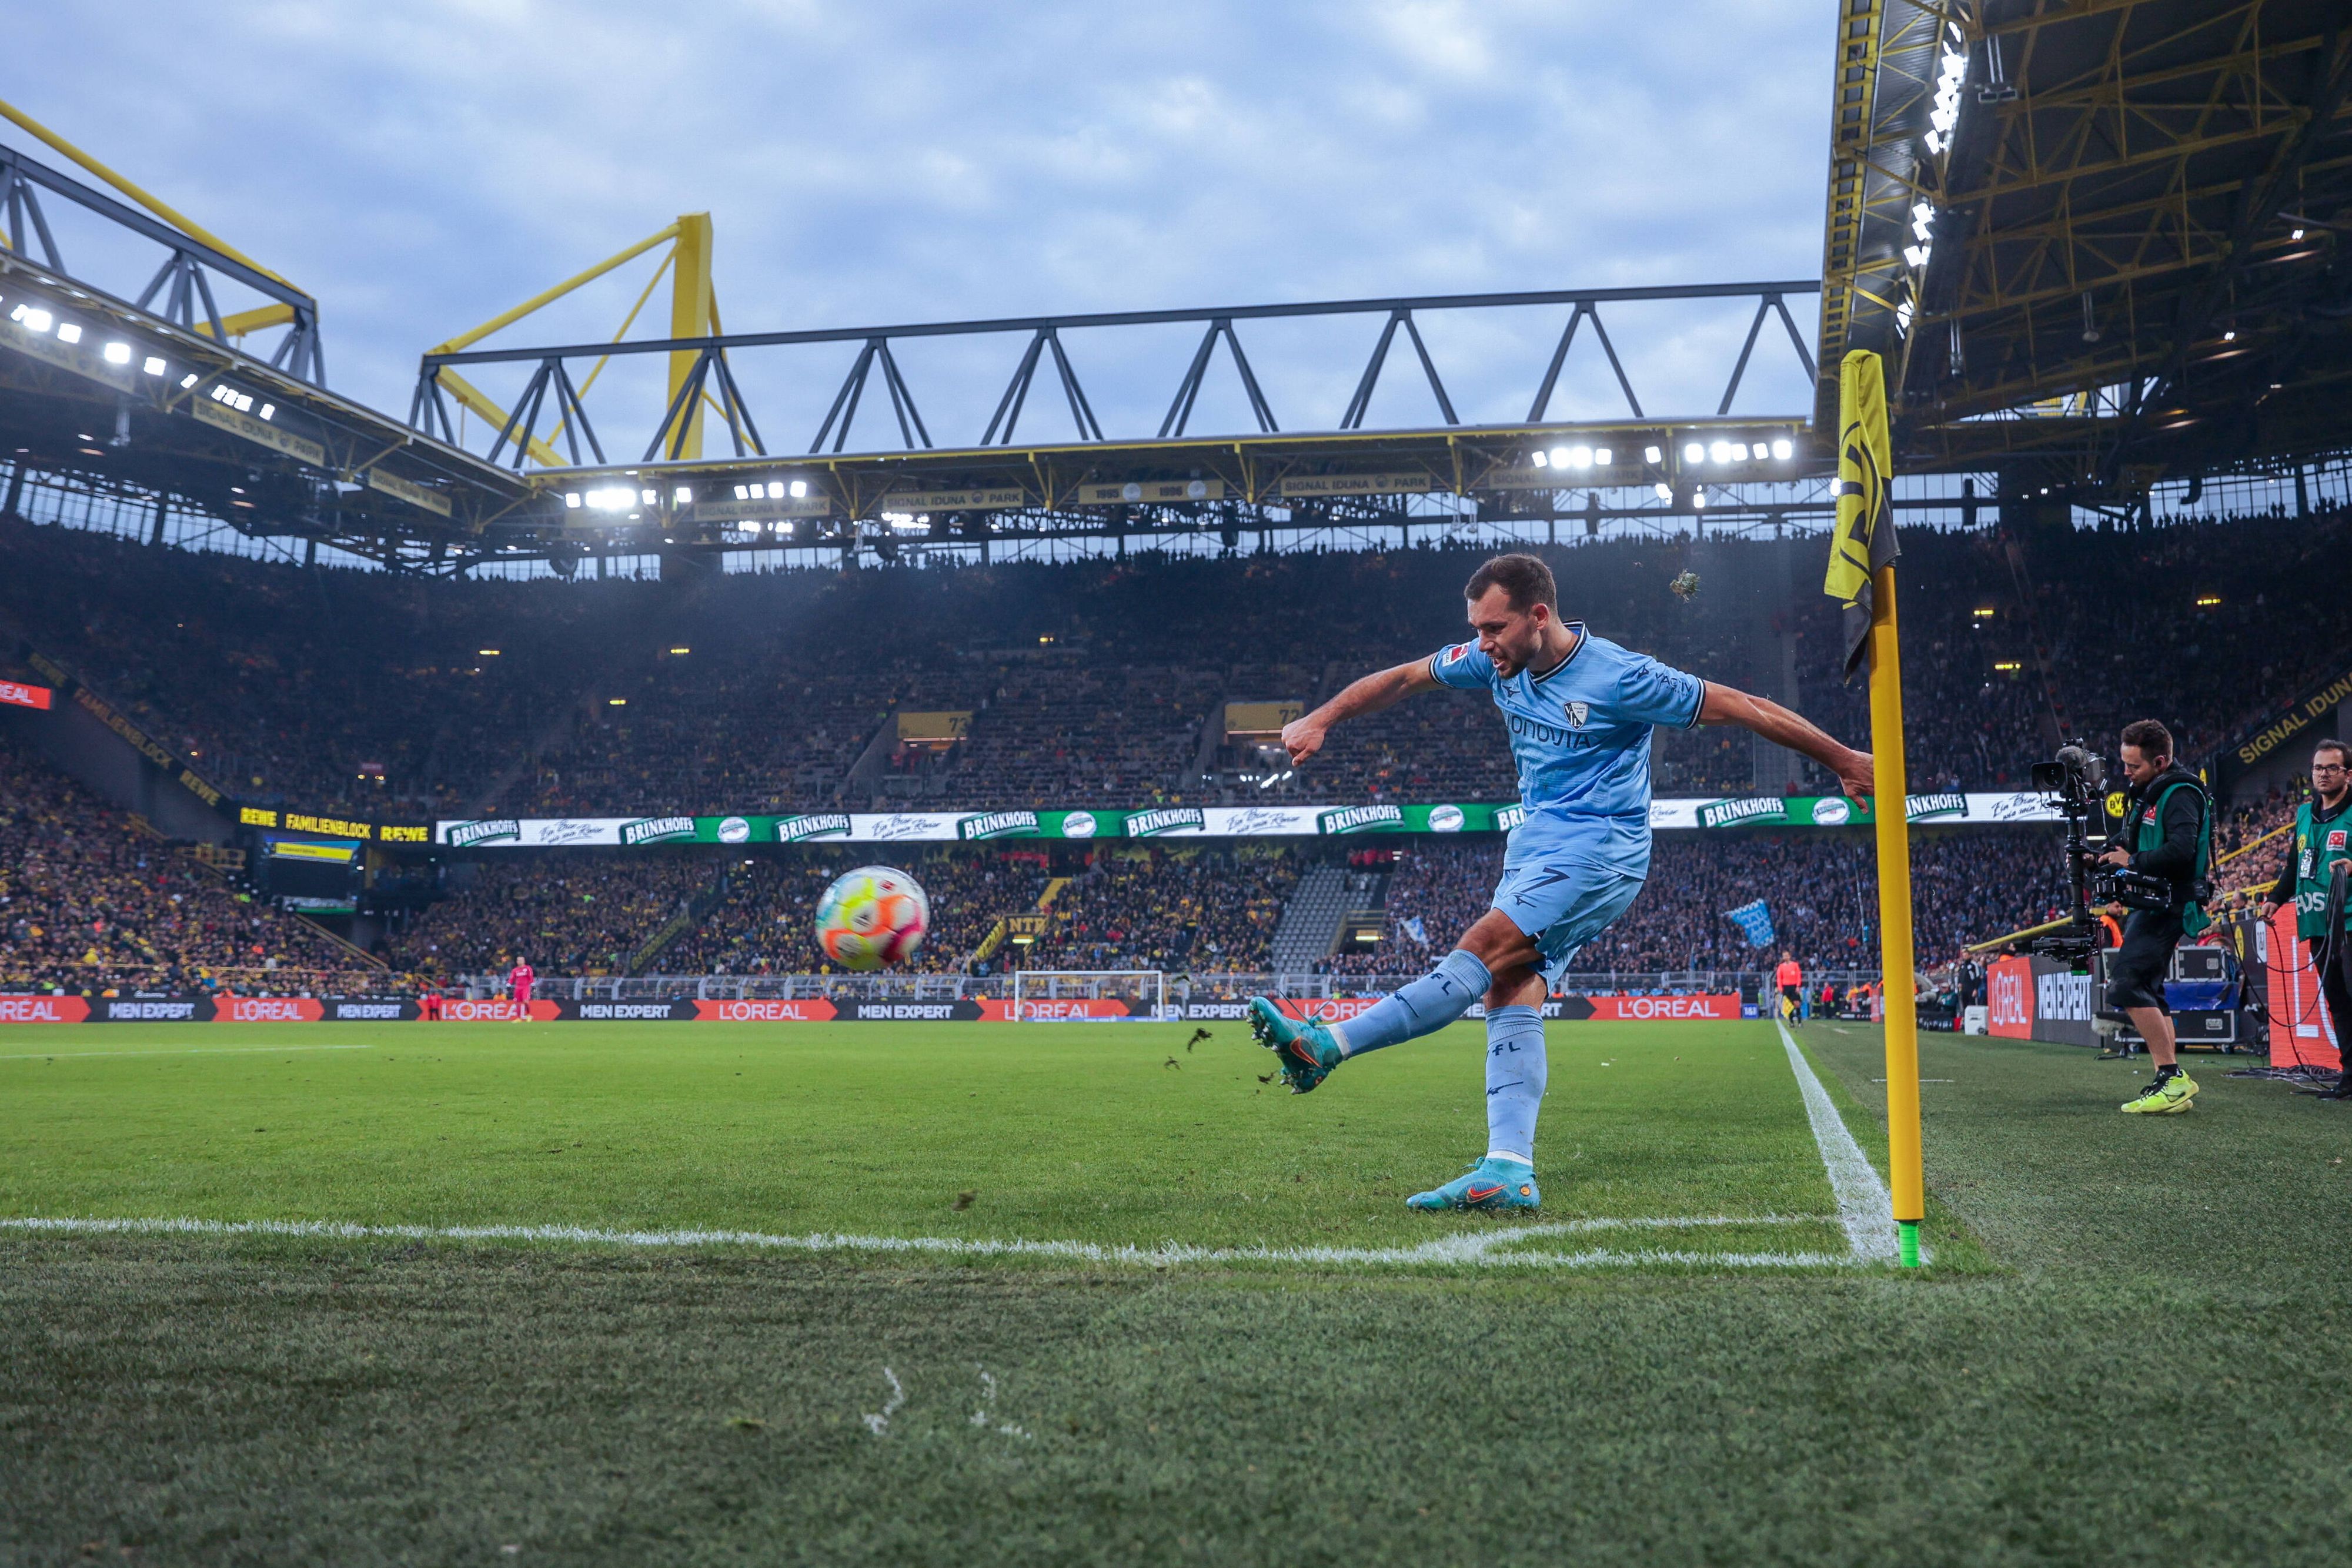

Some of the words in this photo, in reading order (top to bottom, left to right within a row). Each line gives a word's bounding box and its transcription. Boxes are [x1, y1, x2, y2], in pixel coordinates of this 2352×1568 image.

[1285, 480, 1329, 491] SIGNAL
[1332, 479, 1369, 489] IDUNA
[1394, 477, 1426, 487] PARK
[931, 495, 966, 506] IDUNA
[989, 492, 1020, 503] PARK
[2239, 713, 2308, 764] SIGNAL
[1905, 794, 1965, 815] INKHOFF's
[1992, 968, 2027, 1026] L'ORÉAL
[2038, 973, 2057, 1020] MEN
[2057, 971, 2092, 1021] EXPERT
[108, 1002, 141, 1019] MEN
[142, 1002, 195, 1019] EXPERT
[233, 1000, 304, 1021] L'ORÉAL
[336, 1004, 360, 1019] MEN
[362, 1004, 402, 1019] EXPERT
[580, 1004, 613, 1019] MEN
[614, 1004, 671, 1019] EXPERT
[719, 1002, 807, 1021] L'ORÉAL
[858, 1004, 893, 1019] MEN
[894, 1004, 953, 1019] EXPERT
[1004, 1001, 1089, 1020] LORÉAL
[1304, 1000, 1370, 1021] L'ORÉ
[1618, 997, 1720, 1018] L'ORÉAL
